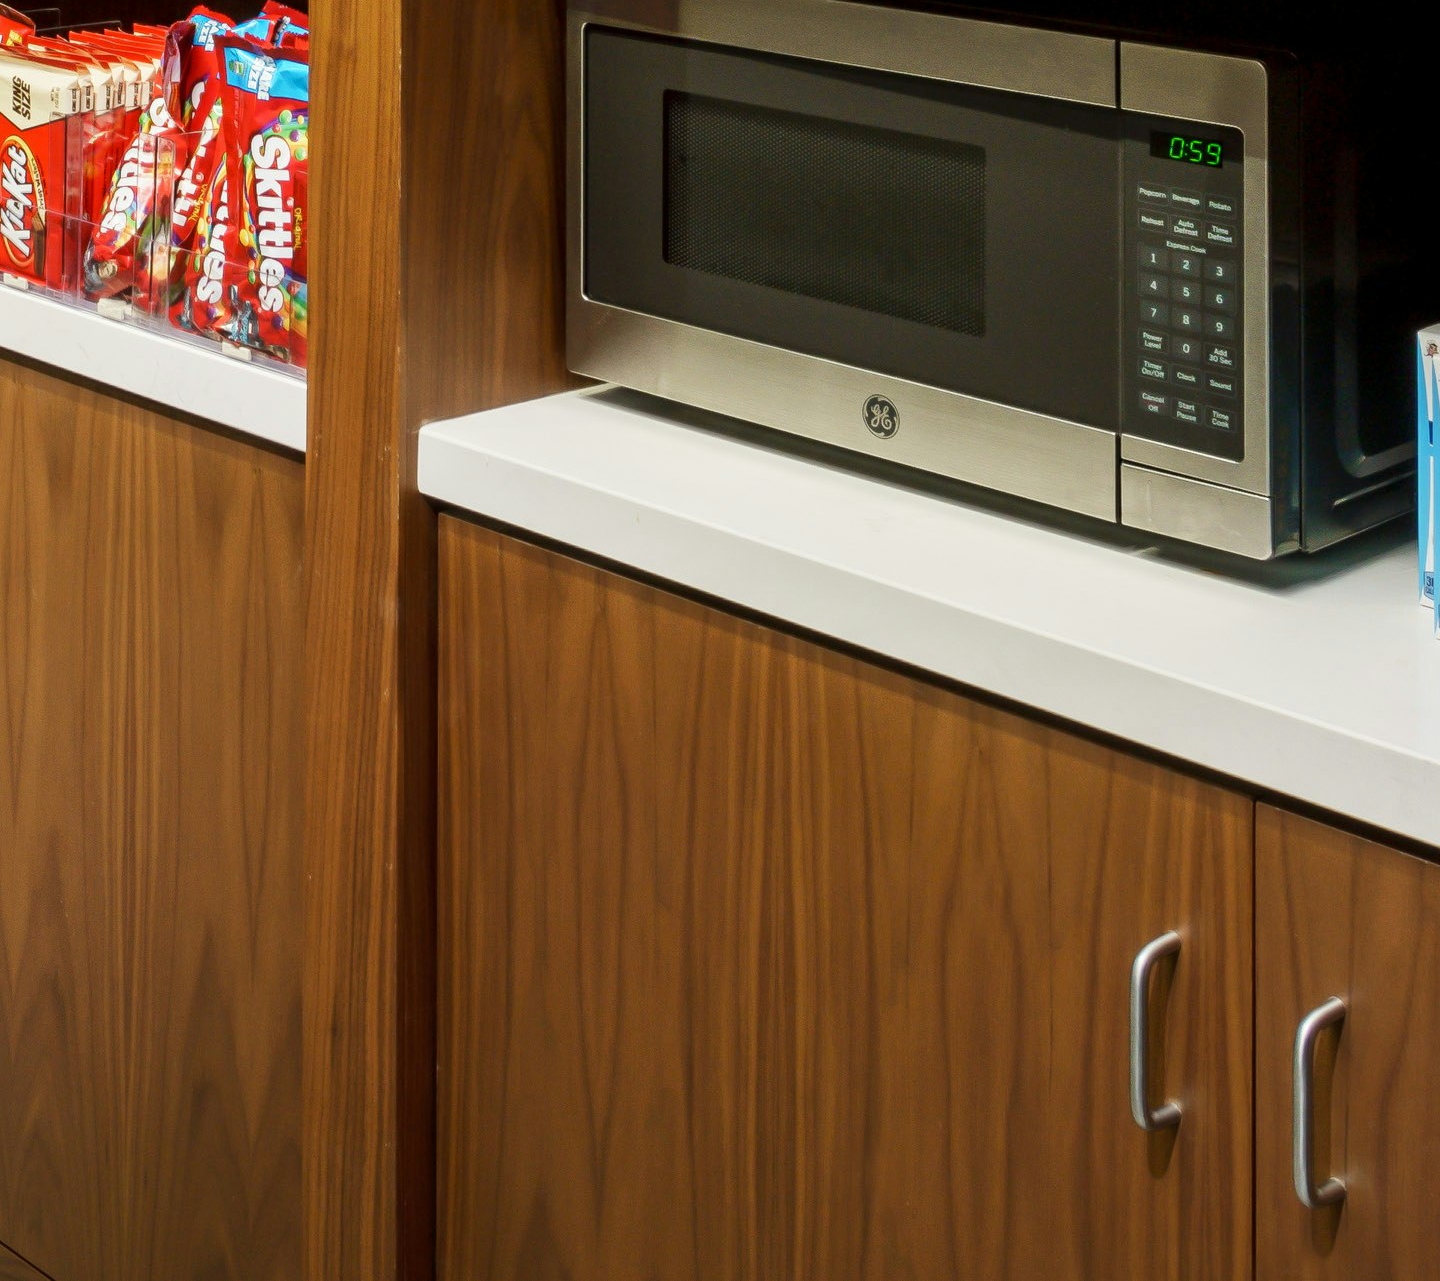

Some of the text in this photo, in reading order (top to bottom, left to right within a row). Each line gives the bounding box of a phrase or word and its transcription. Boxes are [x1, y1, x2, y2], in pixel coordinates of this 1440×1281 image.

[12, 75, 21, 115] KING
[22, 83, 31, 120] SIZE
[1170, 137, 1221, 165] 0:59
[1140, 187, 1166, 200] Popcorn
[251, 134, 294, 313] Skittles
[1183, 260, 1223, 276] 2 3
[1150, 281, 1223, 304] 4 5 6
